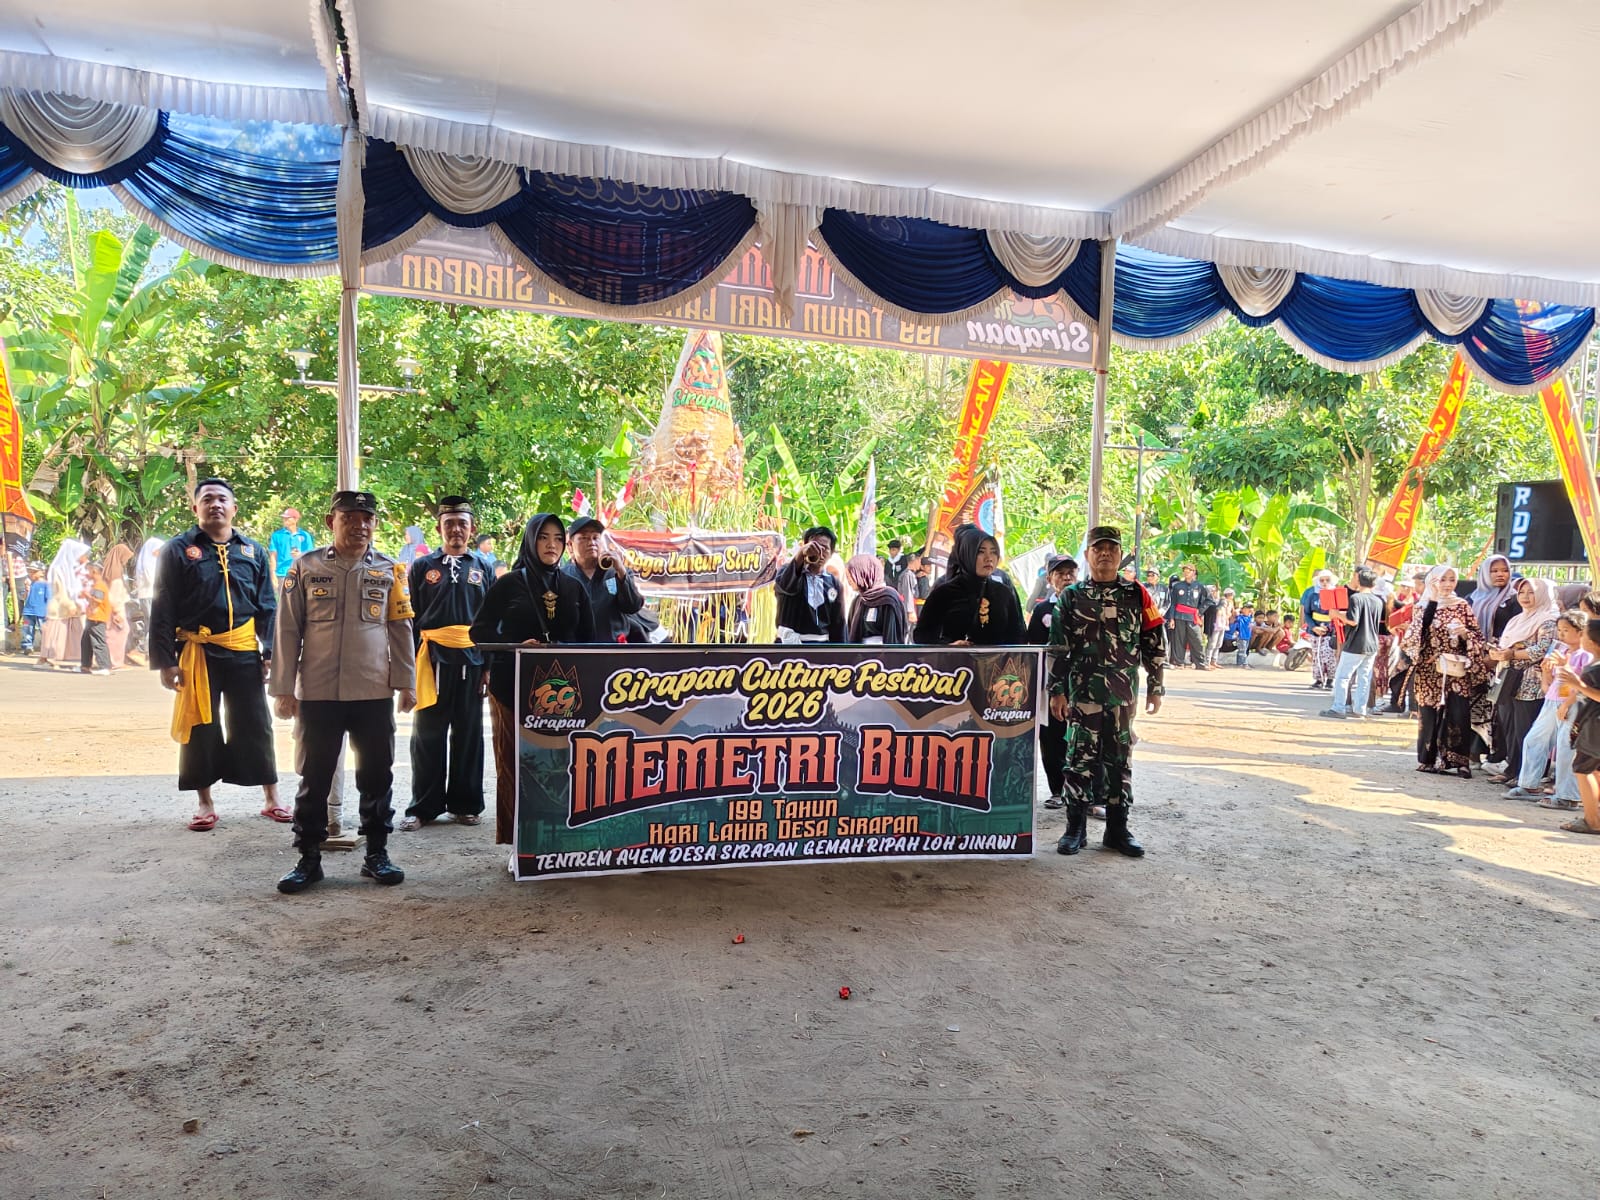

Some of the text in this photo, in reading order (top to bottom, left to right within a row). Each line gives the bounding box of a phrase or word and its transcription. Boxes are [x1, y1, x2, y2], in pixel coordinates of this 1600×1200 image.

[608, 661, 968, 705] Sirapan Culture Festival
[748, 691, 823, 721] 2026
[982, 707, 1032, 722] Sirapan
[524, 714, 586, 731] Sirapan
[572, 728, 993, 814] MEMETRI BUMI
[728, 799, 838, 821] 199 TAHUN
[649, 815, 919, 845] HARI LAHIR DESA SIRAPAN
[535, 834, 1018, 871] TENTREM AYEM DESA SIRAPAN GEMAH RIPAH LOH JINAWI
